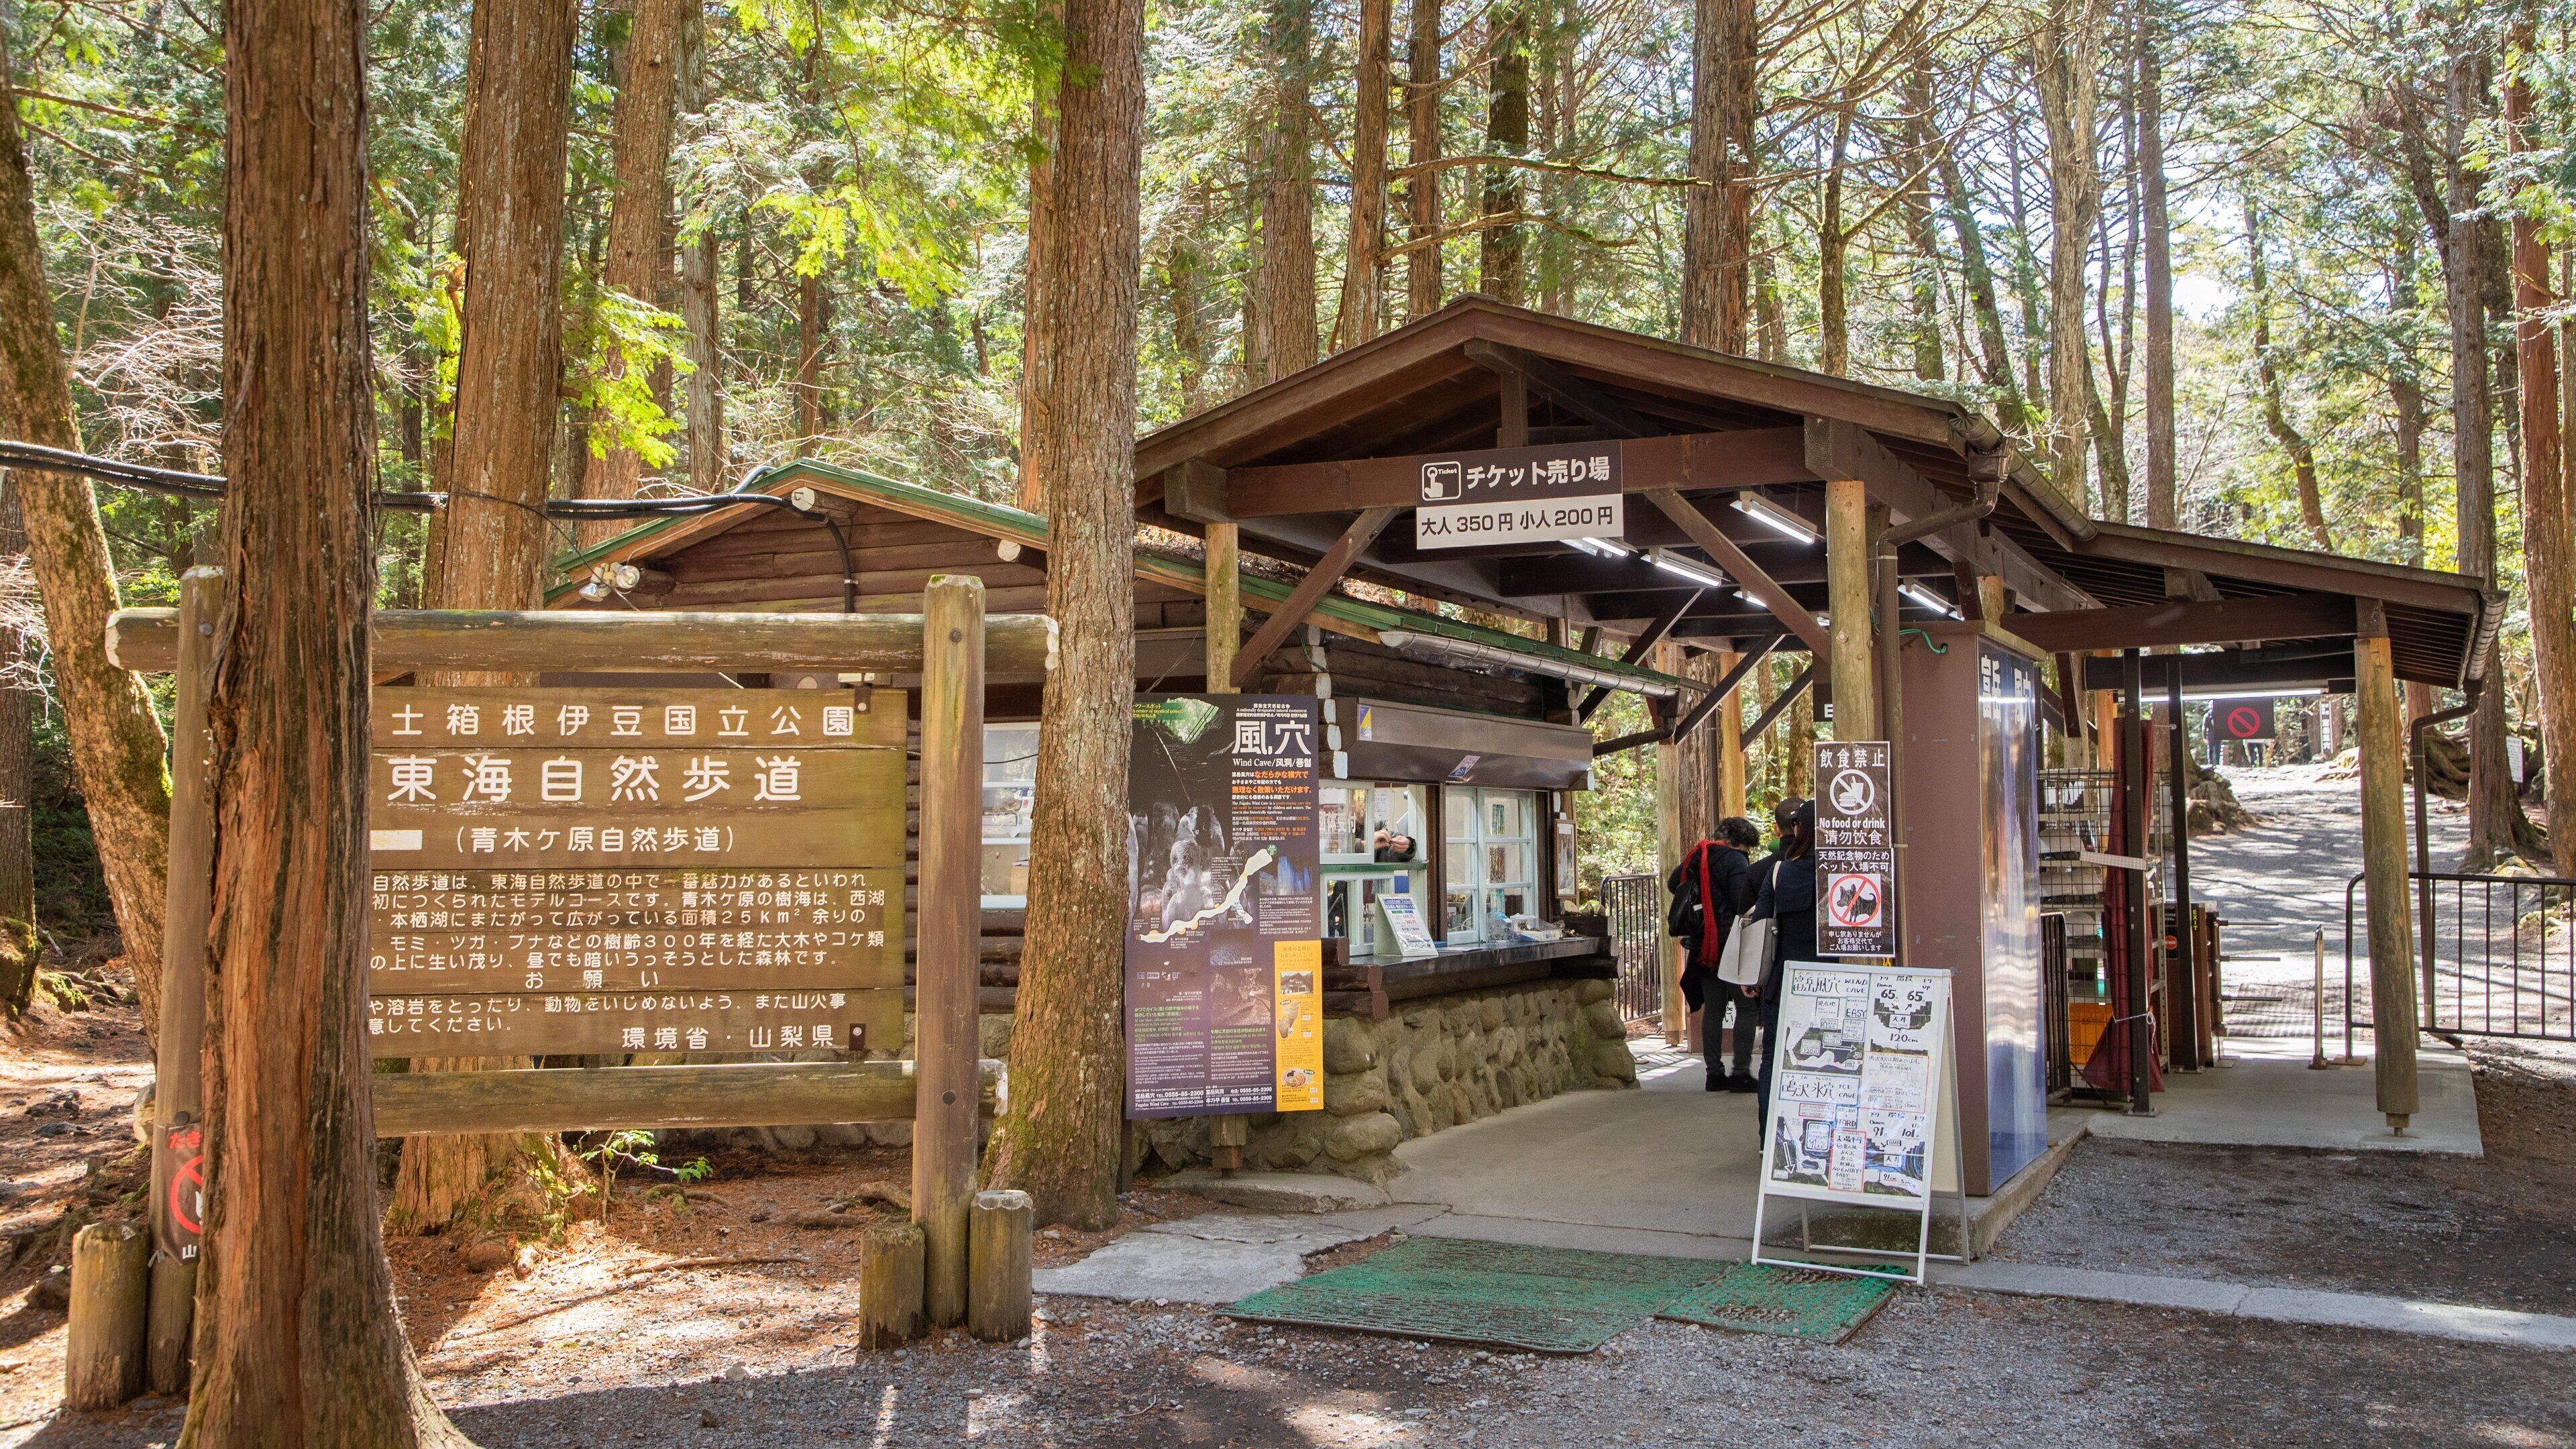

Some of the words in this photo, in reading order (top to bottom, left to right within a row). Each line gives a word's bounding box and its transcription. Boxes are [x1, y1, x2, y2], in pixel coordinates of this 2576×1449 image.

[1466, 455, 1611, 490] チケット売り場
[391, 703, 853, 737] 士箱根伊豆国立公園
[1231, 720, 1312, 755] 風穴
[1232, 758, 1252, 767] Wind
[1820, 748, 1886, 769] 飲食禁止
[387, 754, 802, 802] 東海自然歩道
[1232, 786, 1312, 794] 無理なく散策いただけます。
[1819, 817, 1831, 828] No
[1832, 817, 1853, 828] food
[1853, 819, 1863, 828] or
[1862, 817, 1886, 828] drink
[1824, 829, 1883, 846] 请勿饮食
[1819, 850, 1890, 861] 天然記念物のため
[1819, 861, 1890, 873] ペット入場不可
[1828, 930, 1882, 938] 申し訳ありませんが
[1793, 975, 1840, 994] 富岳風穴
[1844, 978, 1868, 986] WIND
[1846, 1008, 1868, 1018] EASY
[368, 1017, 513, 1034] 意してください。
[621, 1024, 834, 1051] 環境省・山梨県
[1889, 1033, 1919, 1042] 120cm
[1781, 1079, 1835, 1100] 鳴沢氷穴
[1835, 1118, 1857, 1128] HARD
[182, 1244, 197, 1259] 山
